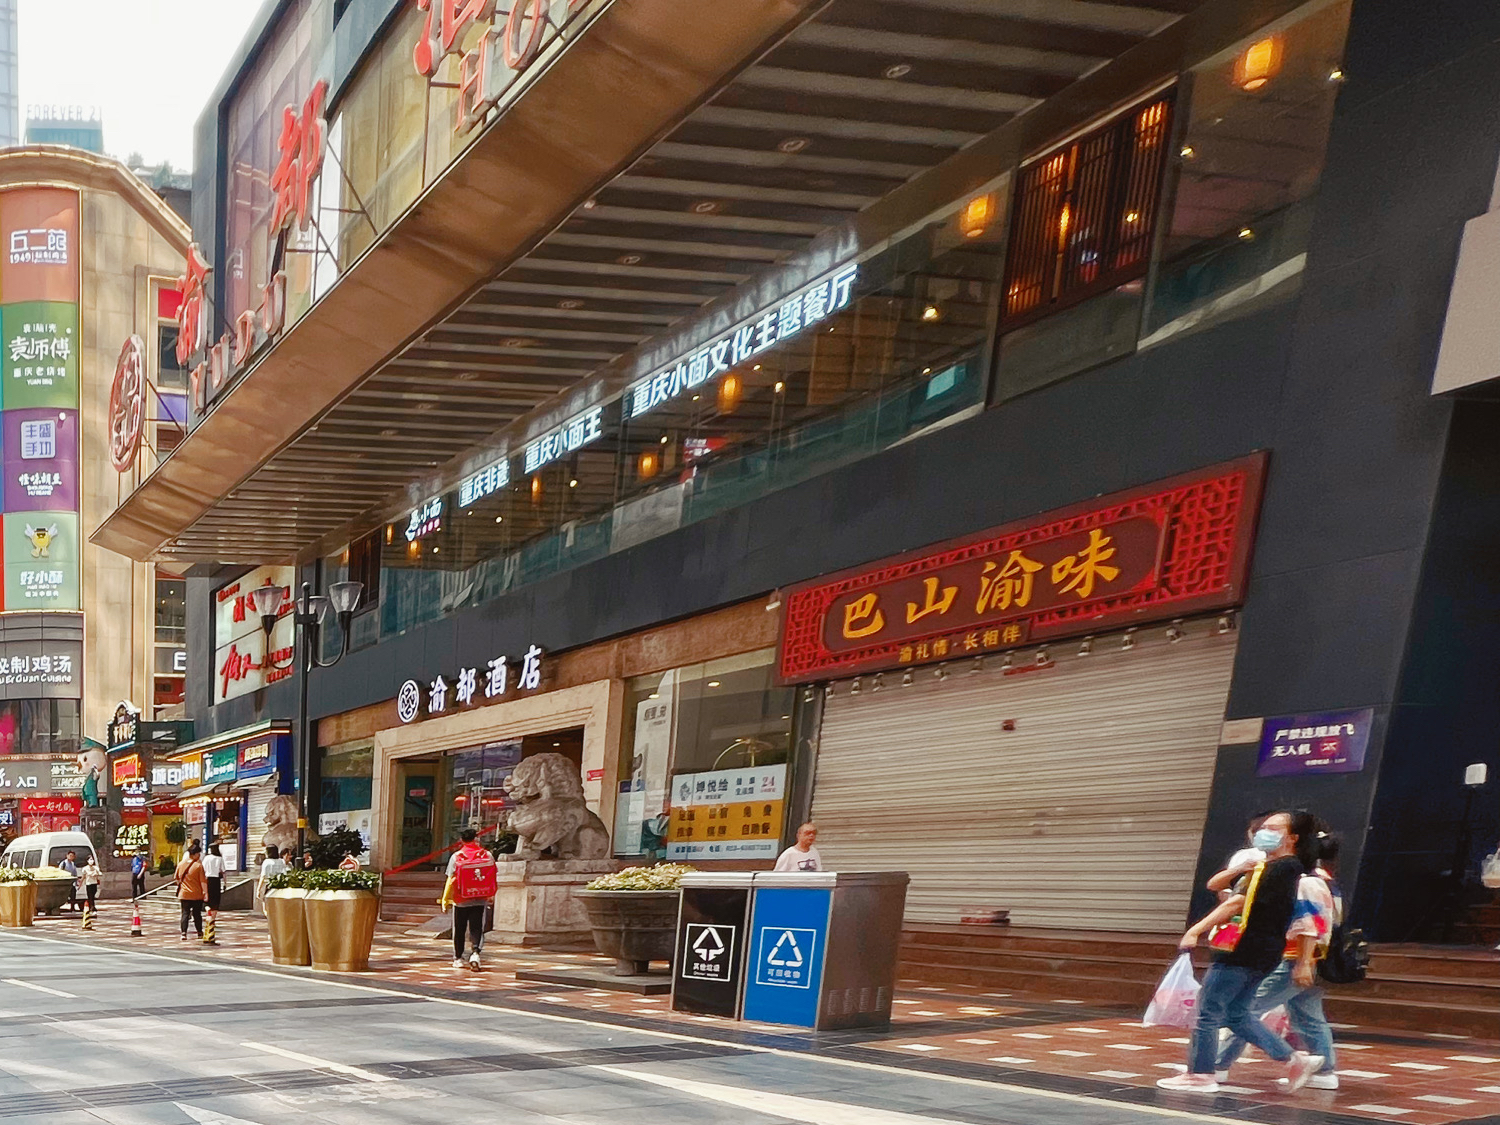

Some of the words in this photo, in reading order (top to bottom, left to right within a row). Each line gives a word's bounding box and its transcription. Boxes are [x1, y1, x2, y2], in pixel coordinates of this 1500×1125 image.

[8, 336, 71, 361] 袁师傅
[631, 263, 859, 418] 重庆小面文化主题餐厅
[524, 406, 604, 475] 重庆小面王
[842, 528, 1121, 640] 巴山渝味
[428, 644, 542, 714] 渝都酒店
[16, 775, 38, 789] 入口
[1270, 743, 1312, 758] 无人机
